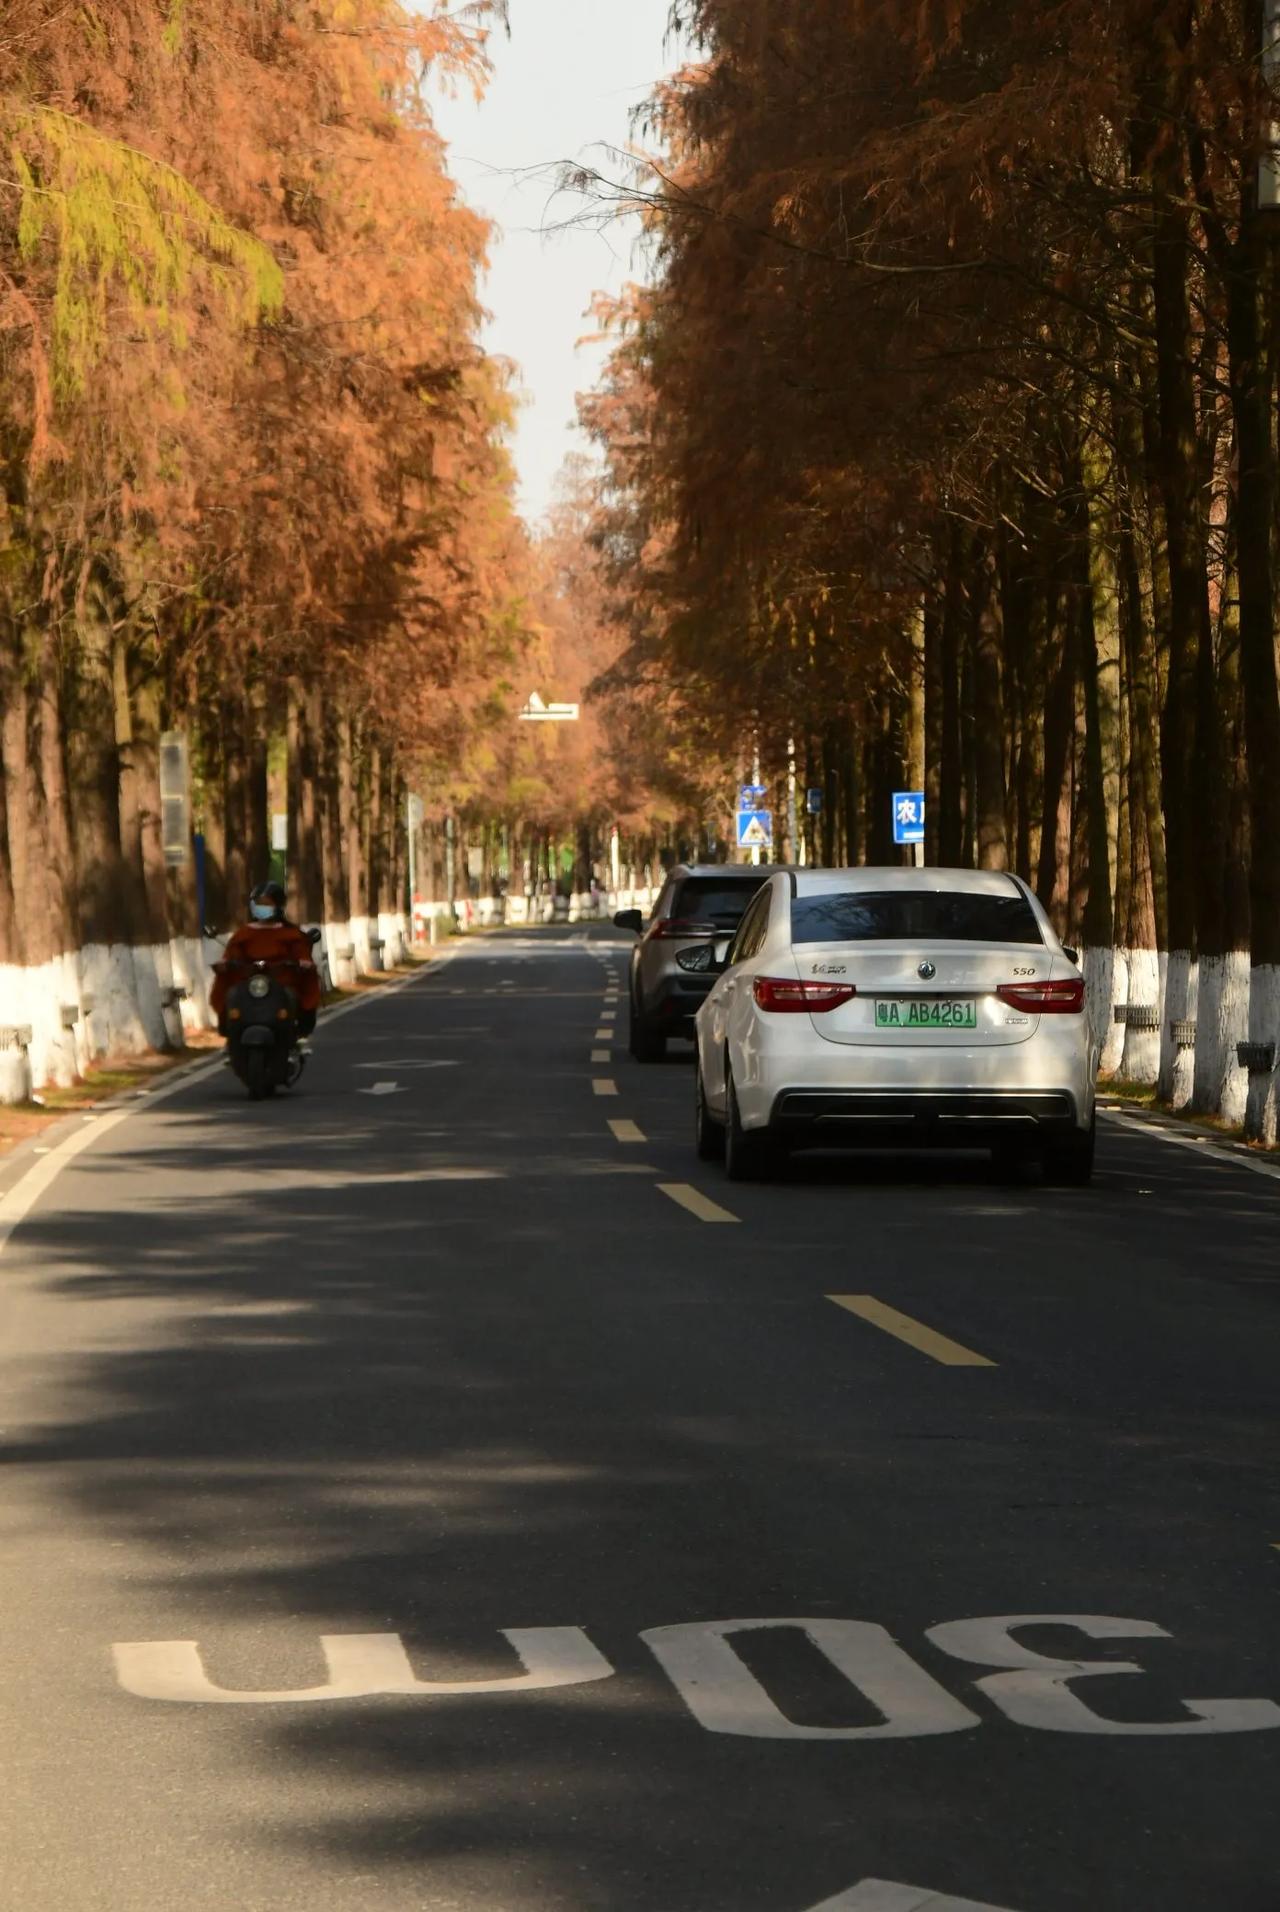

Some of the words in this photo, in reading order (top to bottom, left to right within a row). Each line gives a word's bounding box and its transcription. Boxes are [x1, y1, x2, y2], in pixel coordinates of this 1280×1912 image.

[897, 799, 925, 824] 农
[1012, 967, 1036, 976] S50
[909, 1003, 973, 1023] AB4261
